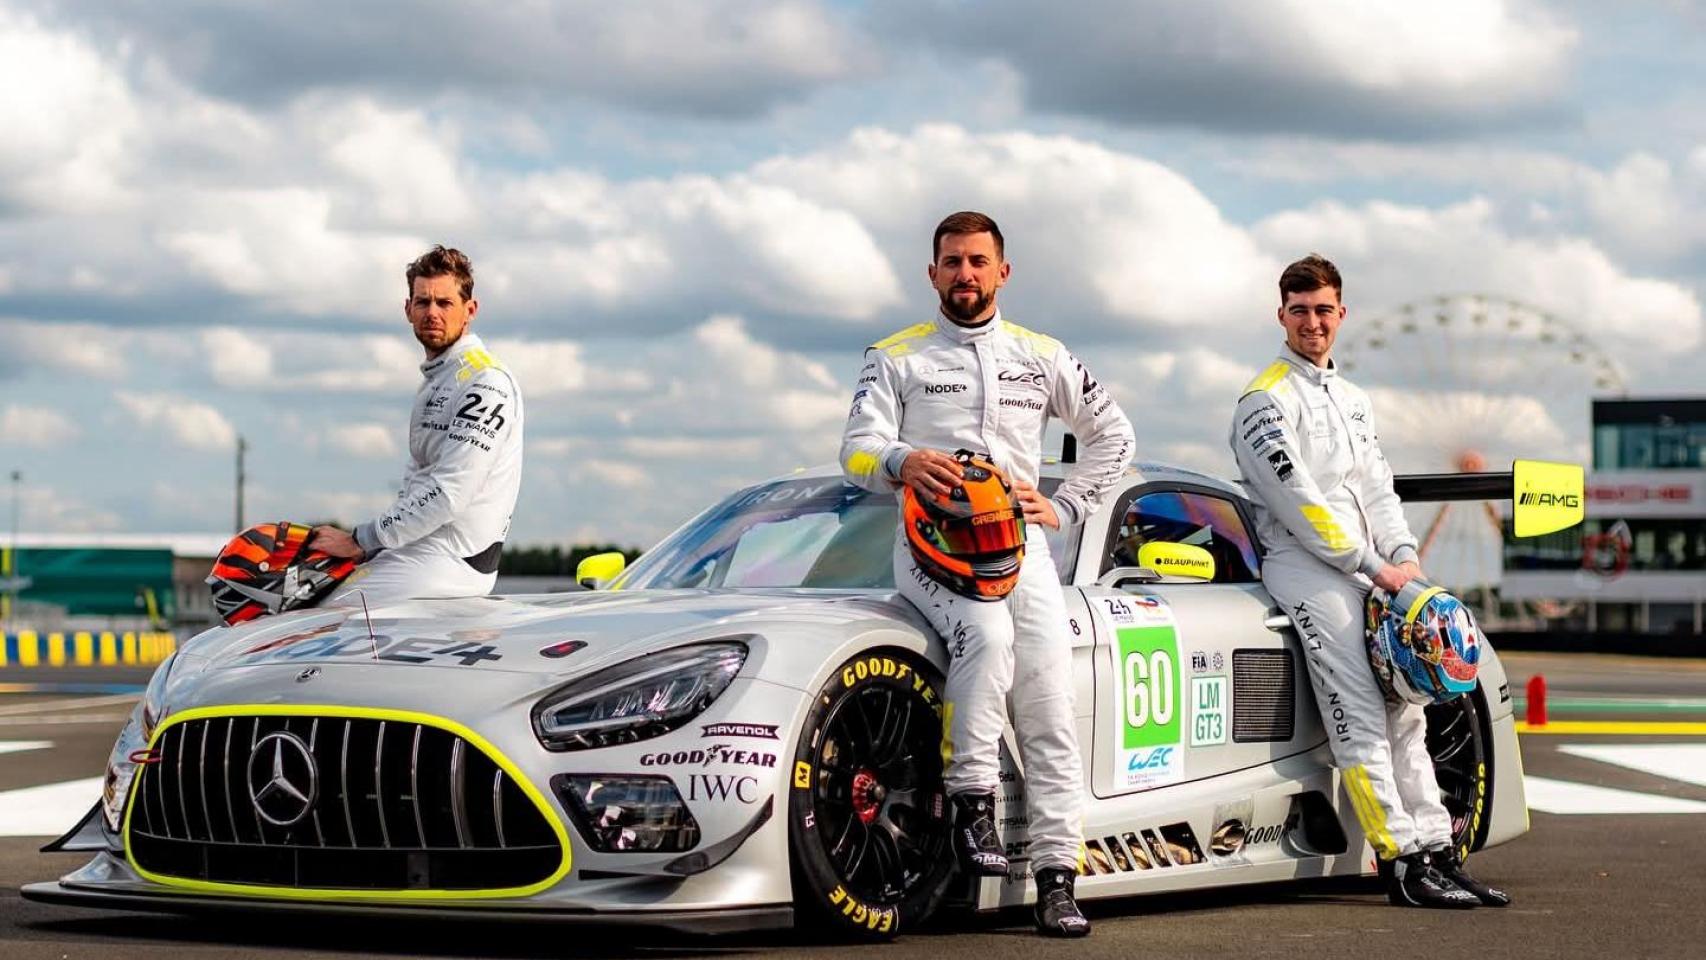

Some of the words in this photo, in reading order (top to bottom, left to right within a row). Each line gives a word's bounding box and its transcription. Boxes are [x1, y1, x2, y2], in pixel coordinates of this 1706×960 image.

[455, 393, 505, 431] 24h
[1163, 557, 1210, 568] BLAUPUNKT
[1293, 601, 1323, 652] LYNX
[1191, 654, 1208, 671] FIA
[1125, 649, 1175, 729] 60
[1199, 682, 1220, 710] LM
[707, 725, 774, 737] RAVENOL
[1195, 713, 1223, 741] GT3
[1327, 692, 1352, 743] IRON
[639, 745, 778, 769] GOODYEAR
[1127, 746, 1174, 771] WEC
[688, 773, 759, 804] IWC
[828, 884, 894, 932] EAGLE
